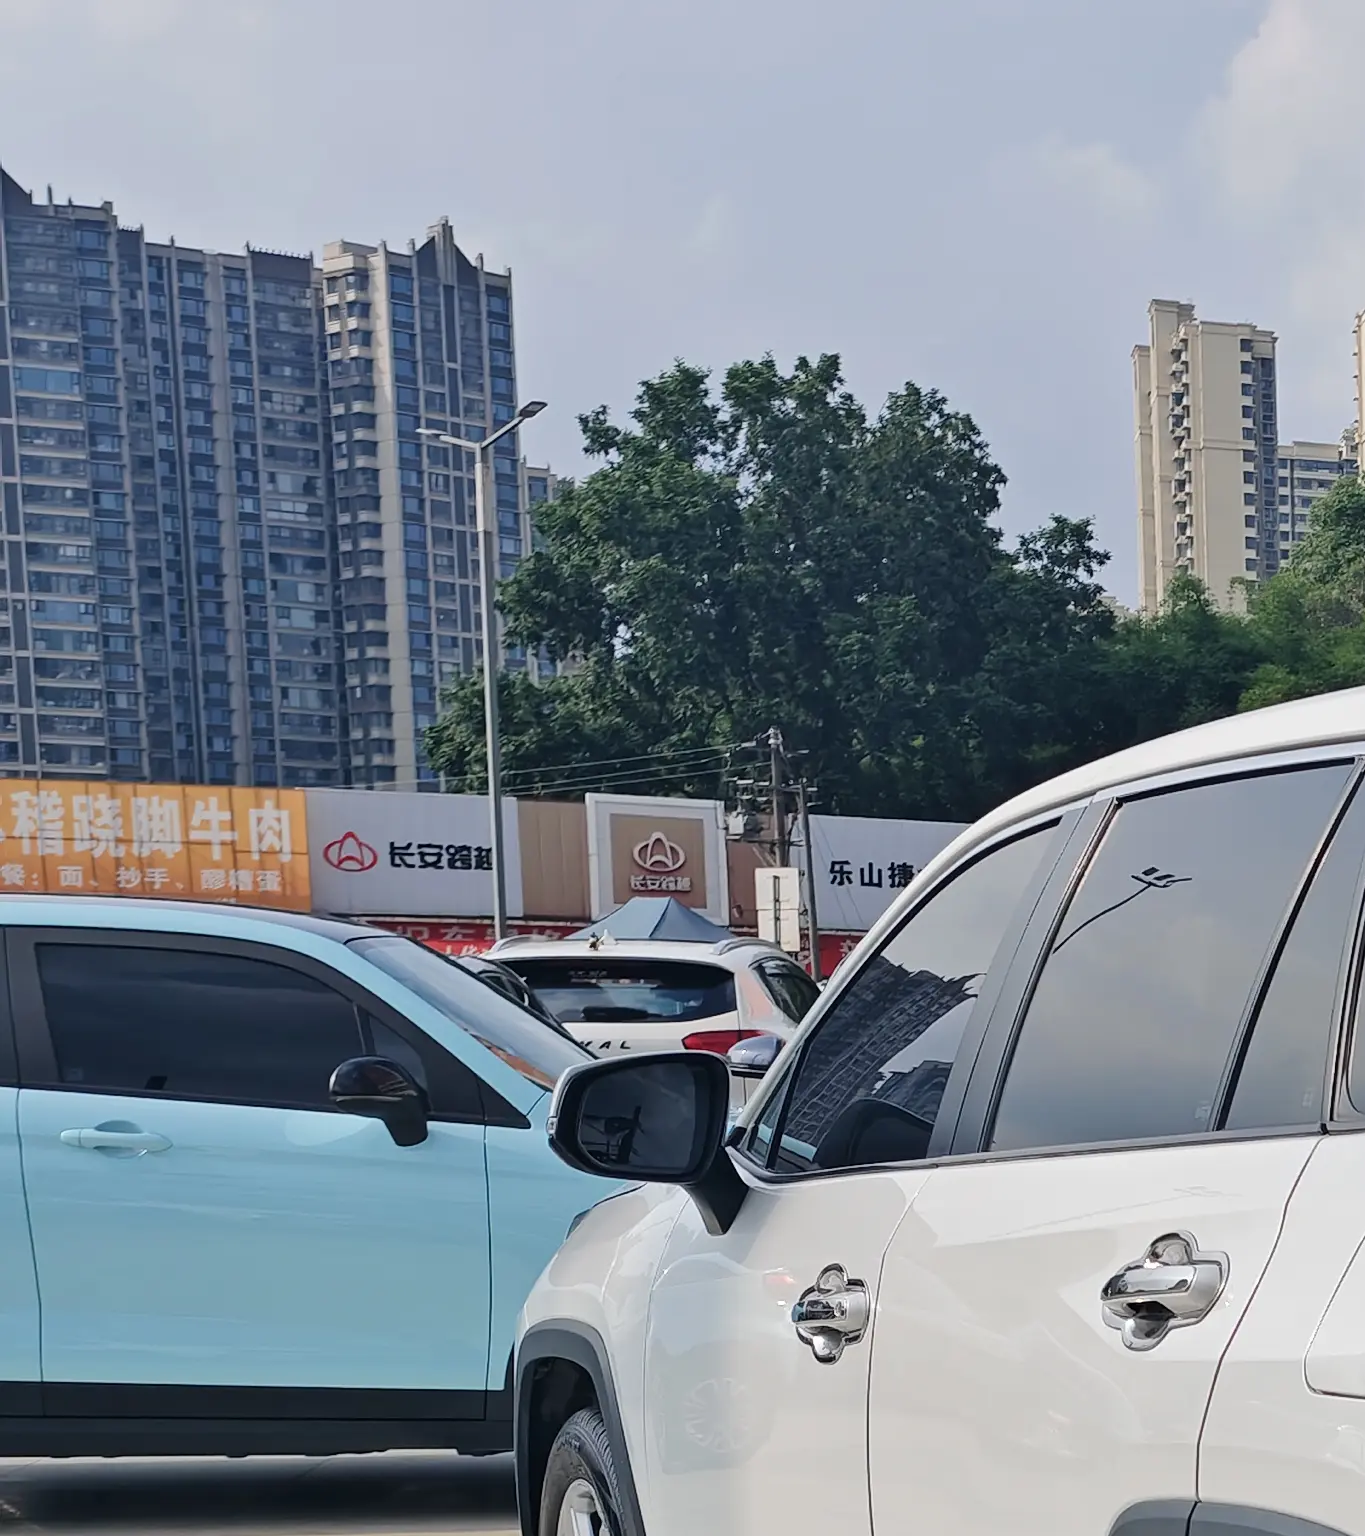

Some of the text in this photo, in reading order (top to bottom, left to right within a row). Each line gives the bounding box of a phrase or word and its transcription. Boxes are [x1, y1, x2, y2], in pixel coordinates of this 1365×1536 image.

[0, 789, 292, 863] 稽跷脚牛肉
[829, 859, 923, 888] 乐山捷
